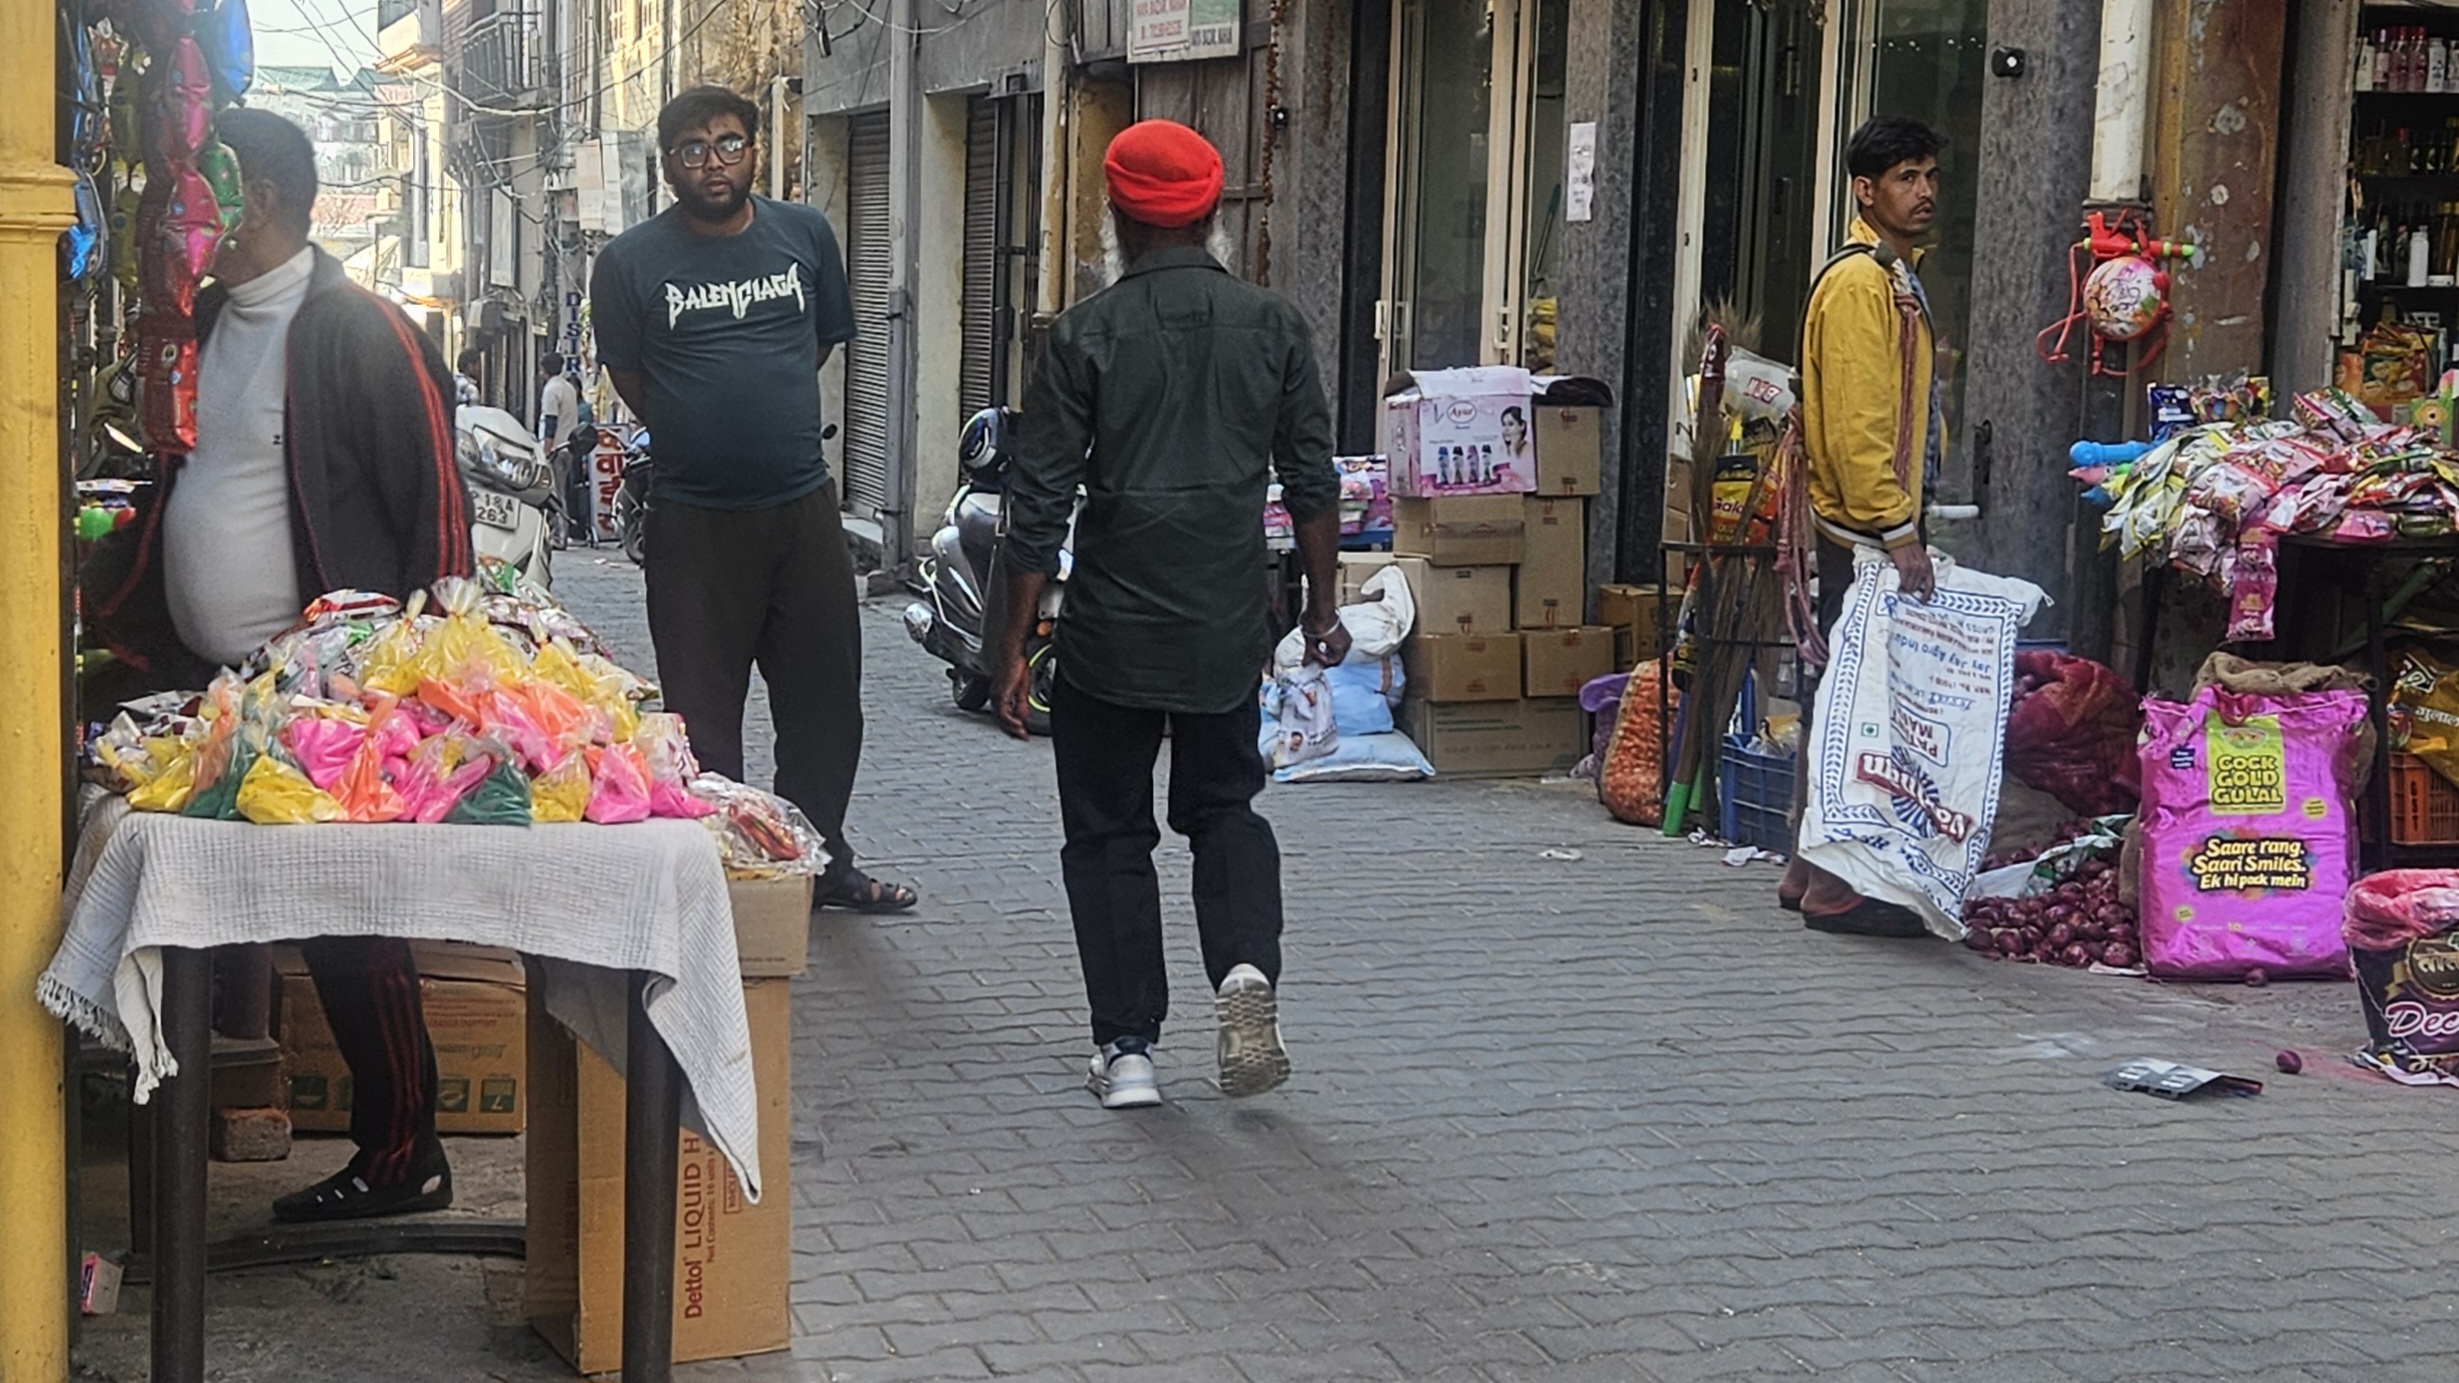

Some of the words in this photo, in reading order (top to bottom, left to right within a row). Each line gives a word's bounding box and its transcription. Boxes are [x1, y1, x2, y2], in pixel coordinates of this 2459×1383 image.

[665, 262, 804, 330] BALENCIAGA
[566, 291, 582, 377] DISTR
[2217, 755, 2278, 770] COCK
[2216, 770, 2279, 786] GOLD
[2212, 787, 2283, 804] GULAL
[2205, 838, 2257, 857] Saare
[2259, 840, 2305, 858] rang.
[2192, 855, 2243, 874] Saari
[2244, 856, 2307, 872] Smiles.
[2200, 874, 2221, 889] Ek
[2224, 874, 2237, 887] hi
[2239, 874, 2268, 889] pack
[2270, 874, 2306, 888] mein
[684, 1163, 705, 1249] LIQUID
[684, 1259, 702, 1319] Dettol
